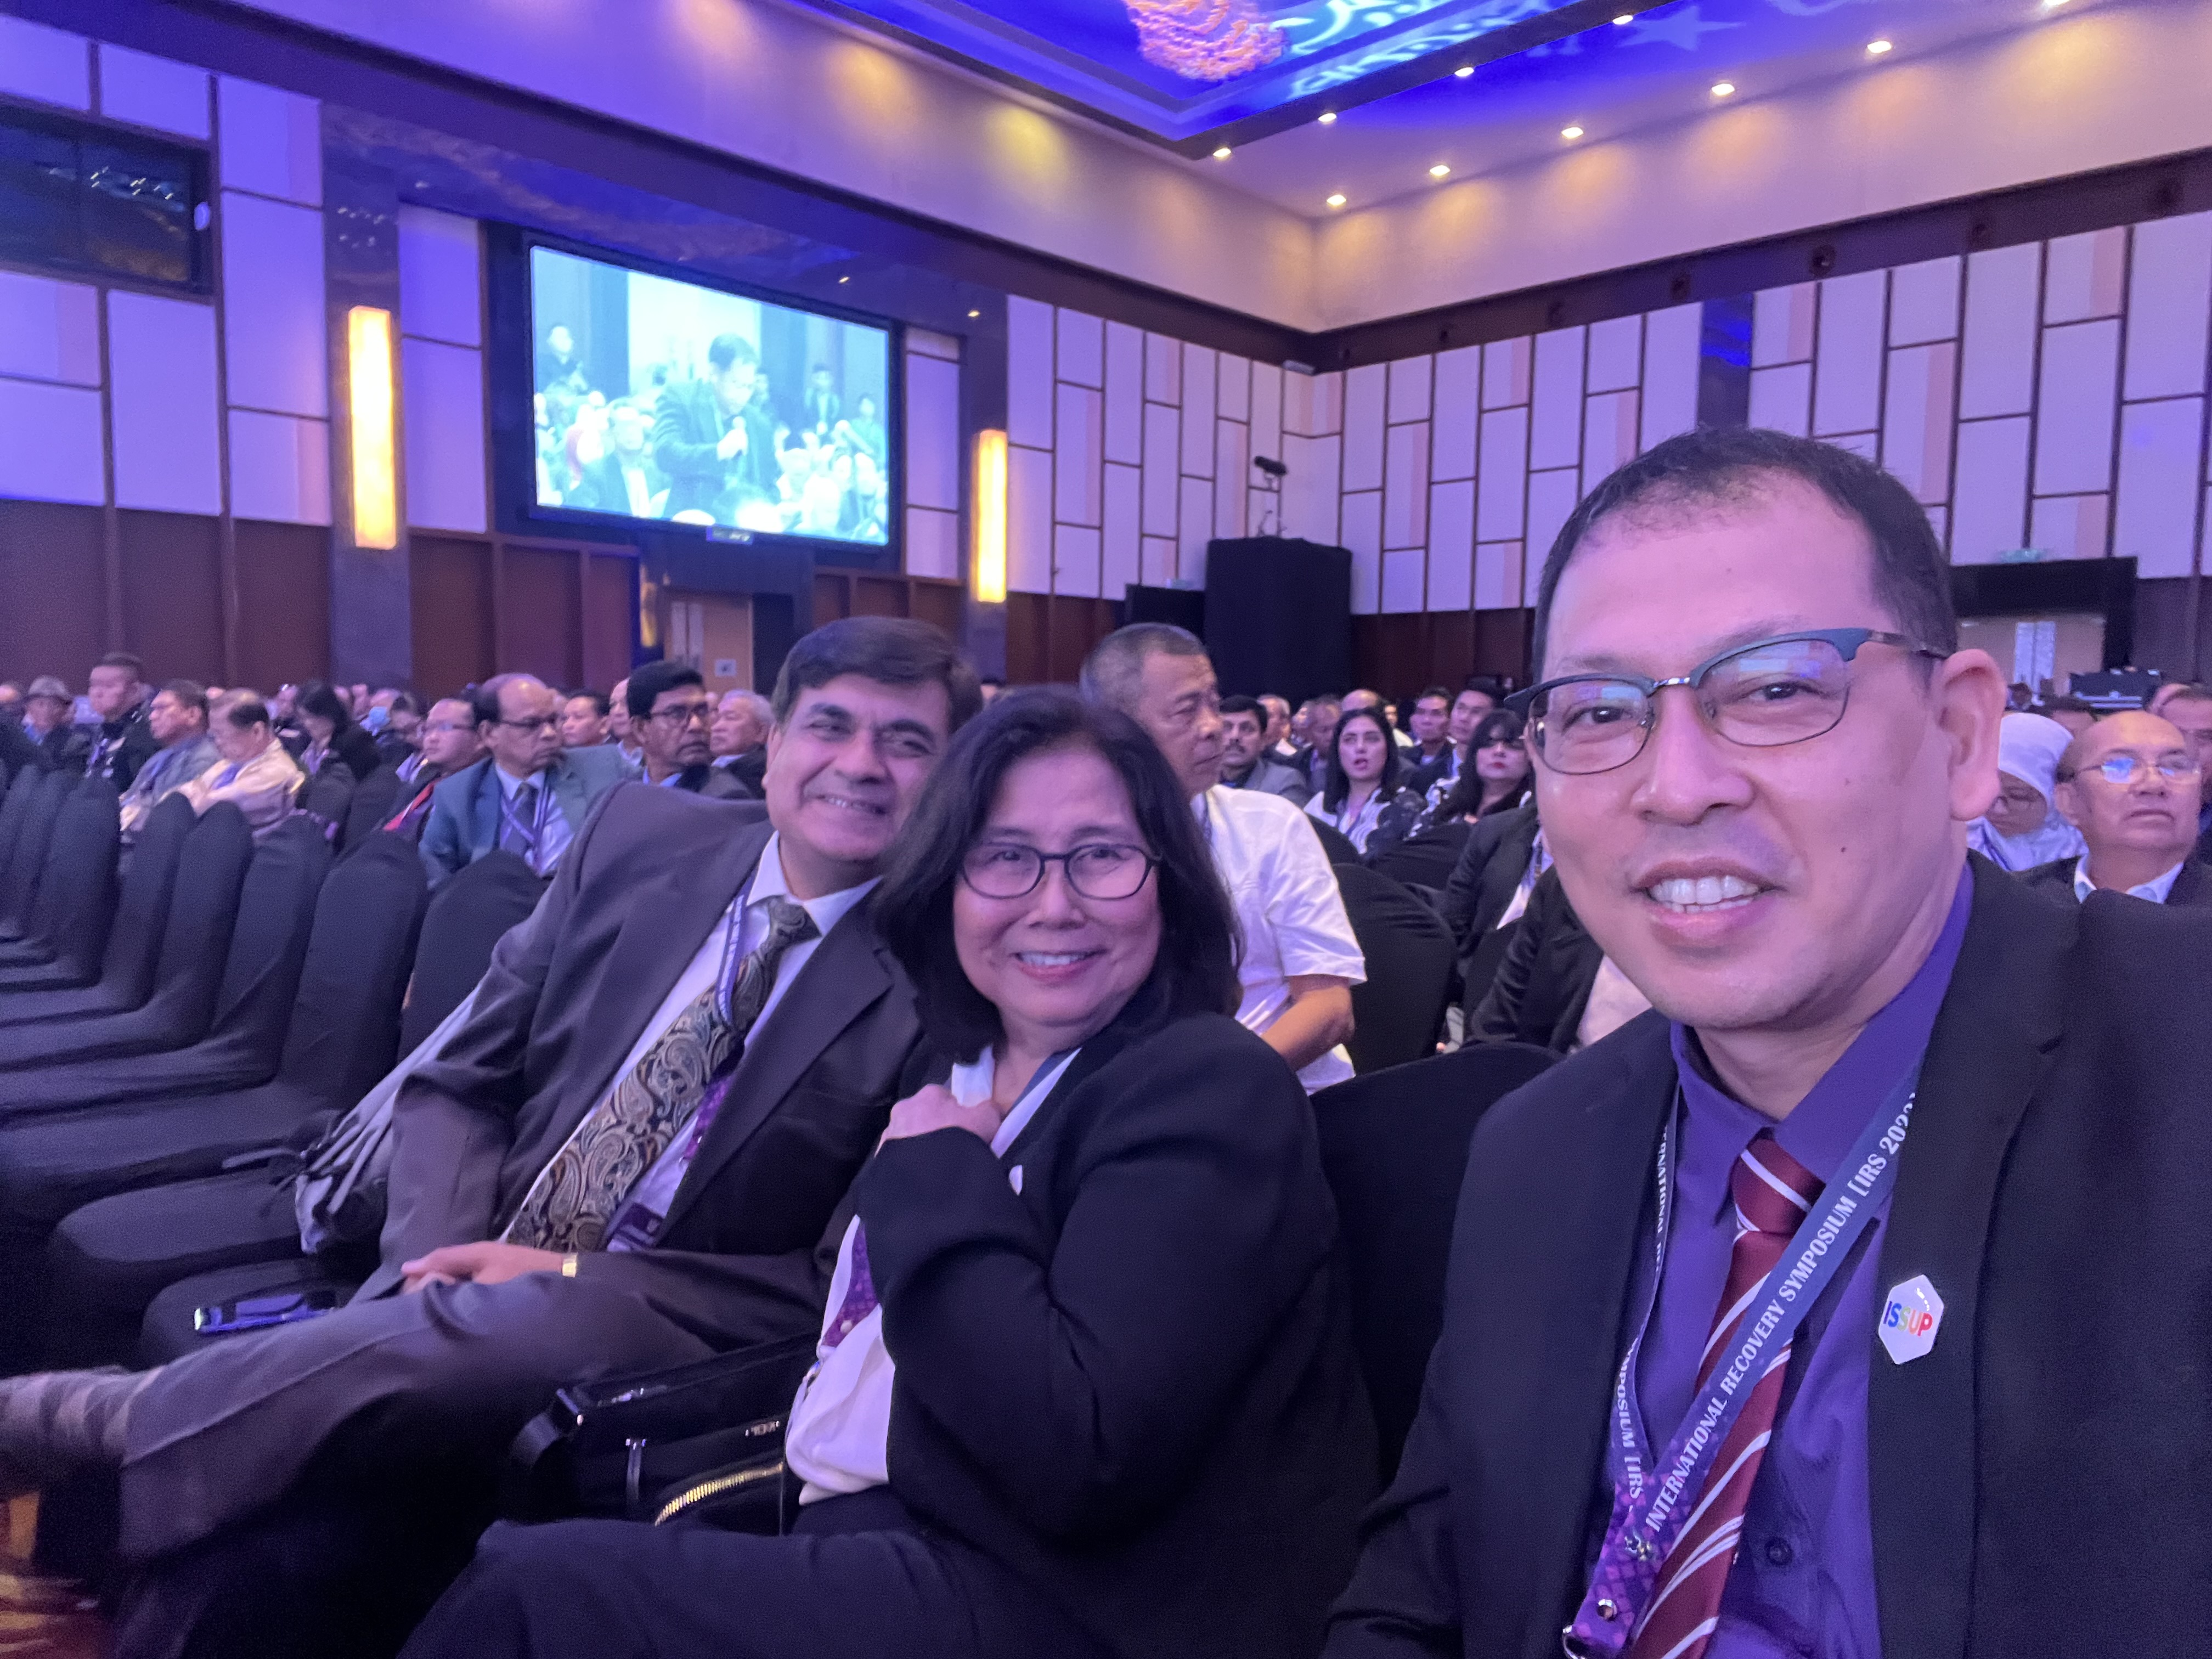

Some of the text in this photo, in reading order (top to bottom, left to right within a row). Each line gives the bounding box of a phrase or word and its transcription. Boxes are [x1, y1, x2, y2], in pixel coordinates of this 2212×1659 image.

[1646, 1397, 1728, 1532] INTERNATIONAL
[1720, 1299, 1785, 1395] RECOVERY
[1779, 1195, 1858, 1301] SYMPOSIUM
[1883, 1301, 1933, 1336] ISSUP
